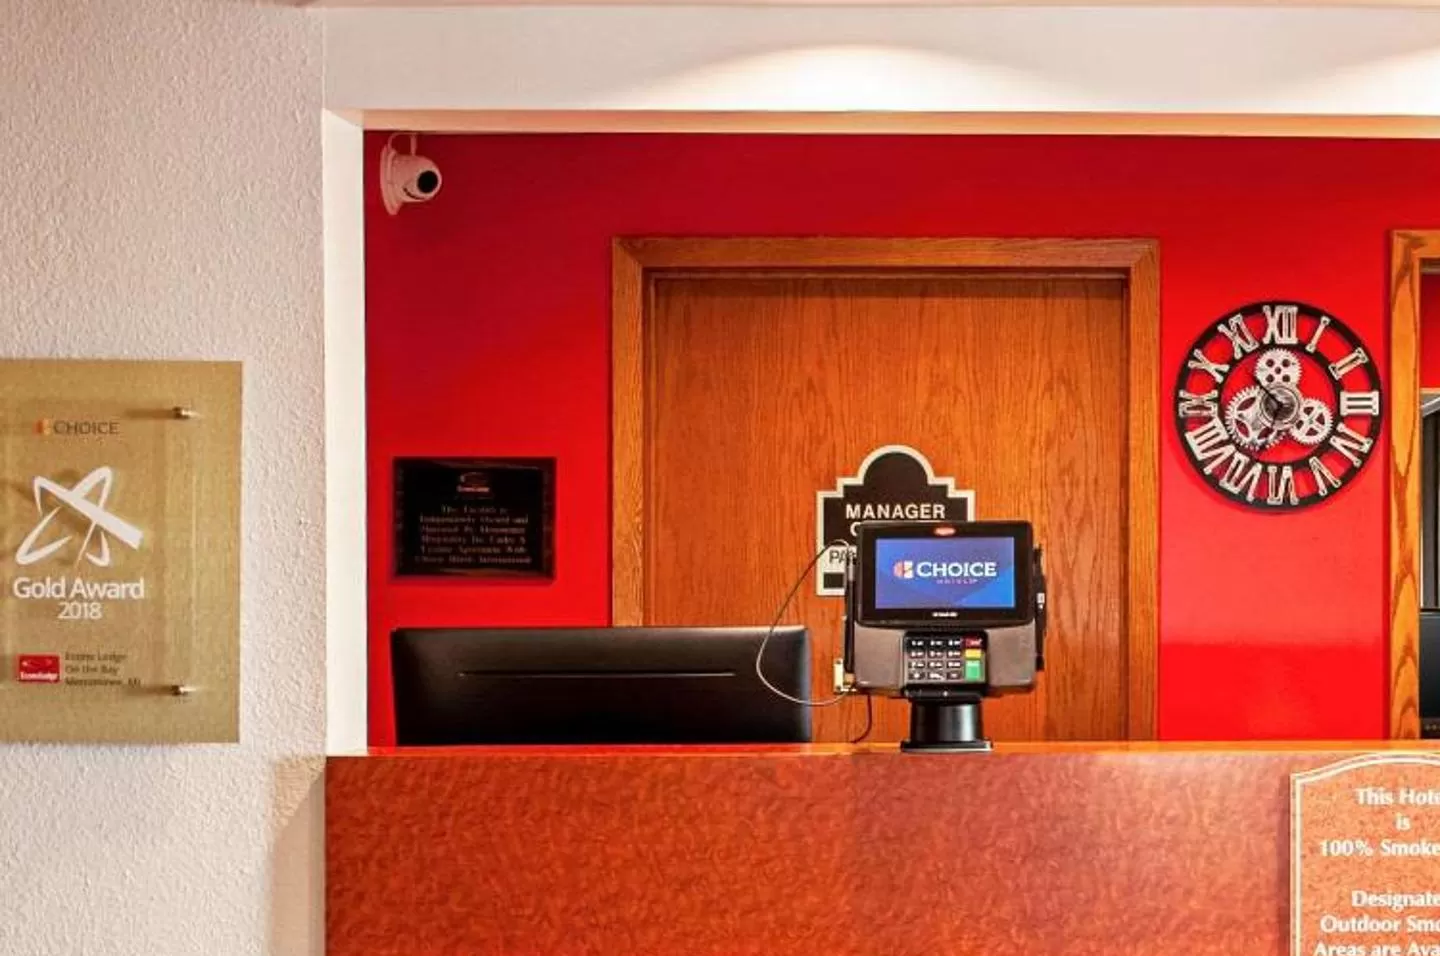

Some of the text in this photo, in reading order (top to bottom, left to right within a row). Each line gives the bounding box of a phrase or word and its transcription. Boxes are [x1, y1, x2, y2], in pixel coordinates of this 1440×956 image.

[1263, 305, 1298, 344] XII
[53, 420, 119, 436] CHOICE
[845, 503, 946, 519] MANAGER
[916, 561, 997, 578] CHOICE
[13, 577, 145, 600] Gold Award
[57, 601, 103, 621] 2018
[1355, 786, 1394, 805] This
[1395, 812, 1411, 831] is
[1319, 838, 1374, 857] 100%
[1320, 915, 1401, 934] Outdoor
